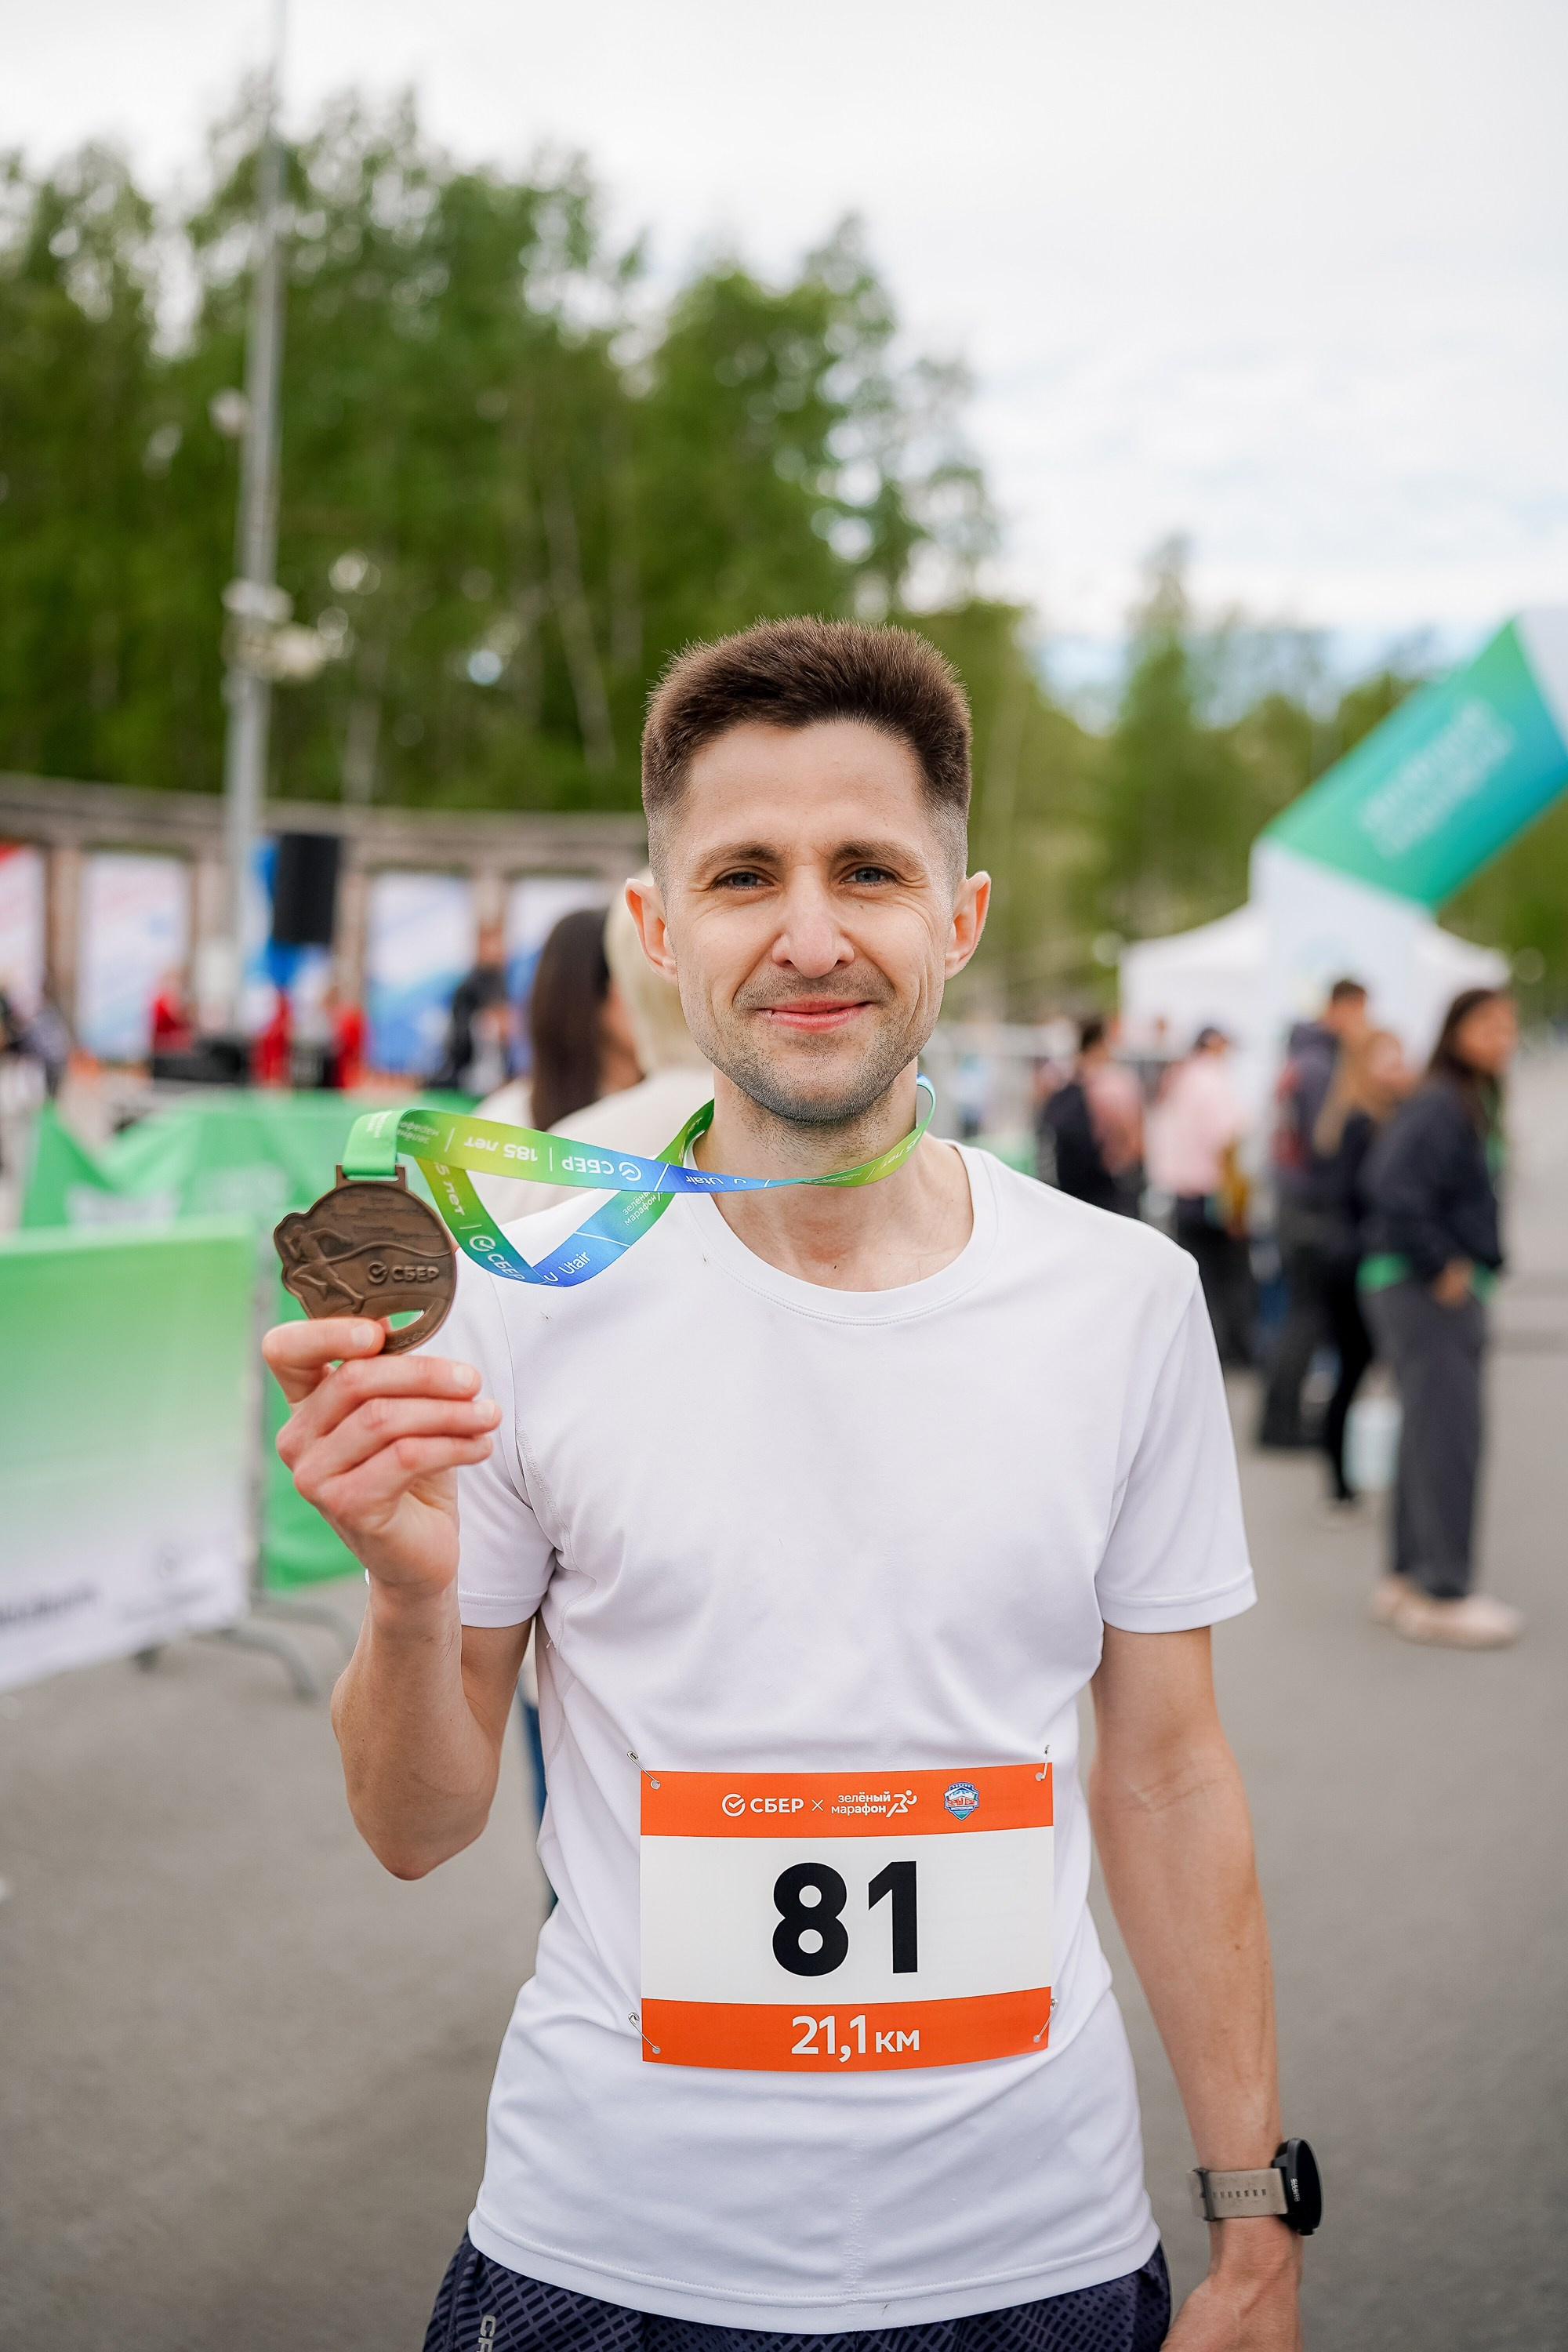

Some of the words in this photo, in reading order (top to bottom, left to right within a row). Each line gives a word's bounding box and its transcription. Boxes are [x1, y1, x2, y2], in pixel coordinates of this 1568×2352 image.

[464, 1137, 499, 1152] лет
[503, 1143, 539, 1162] 185
[561, 1156, 615, 1175] СБЕР
[685, 1175, 724, 1185] Utair
[444, 1181, 465, 1216] лет
[624, 1194, 657, 1226] марафон
[487, 1254, 526, 1279] СБЕР
[558, 1251, 591, 1275] Utair
[392, 1265, 440, 1282] СБЕР
[750, 1798, 804, 1813] СБЕР
[838, 1790, 891, 1803] зелёный
[831, 1802, 887, 1817] марафон
[771, 1860, 919, 1978] 81
[791, 2014, 866, 2063] 21,1
[875, 2029, 920, 2053] км
